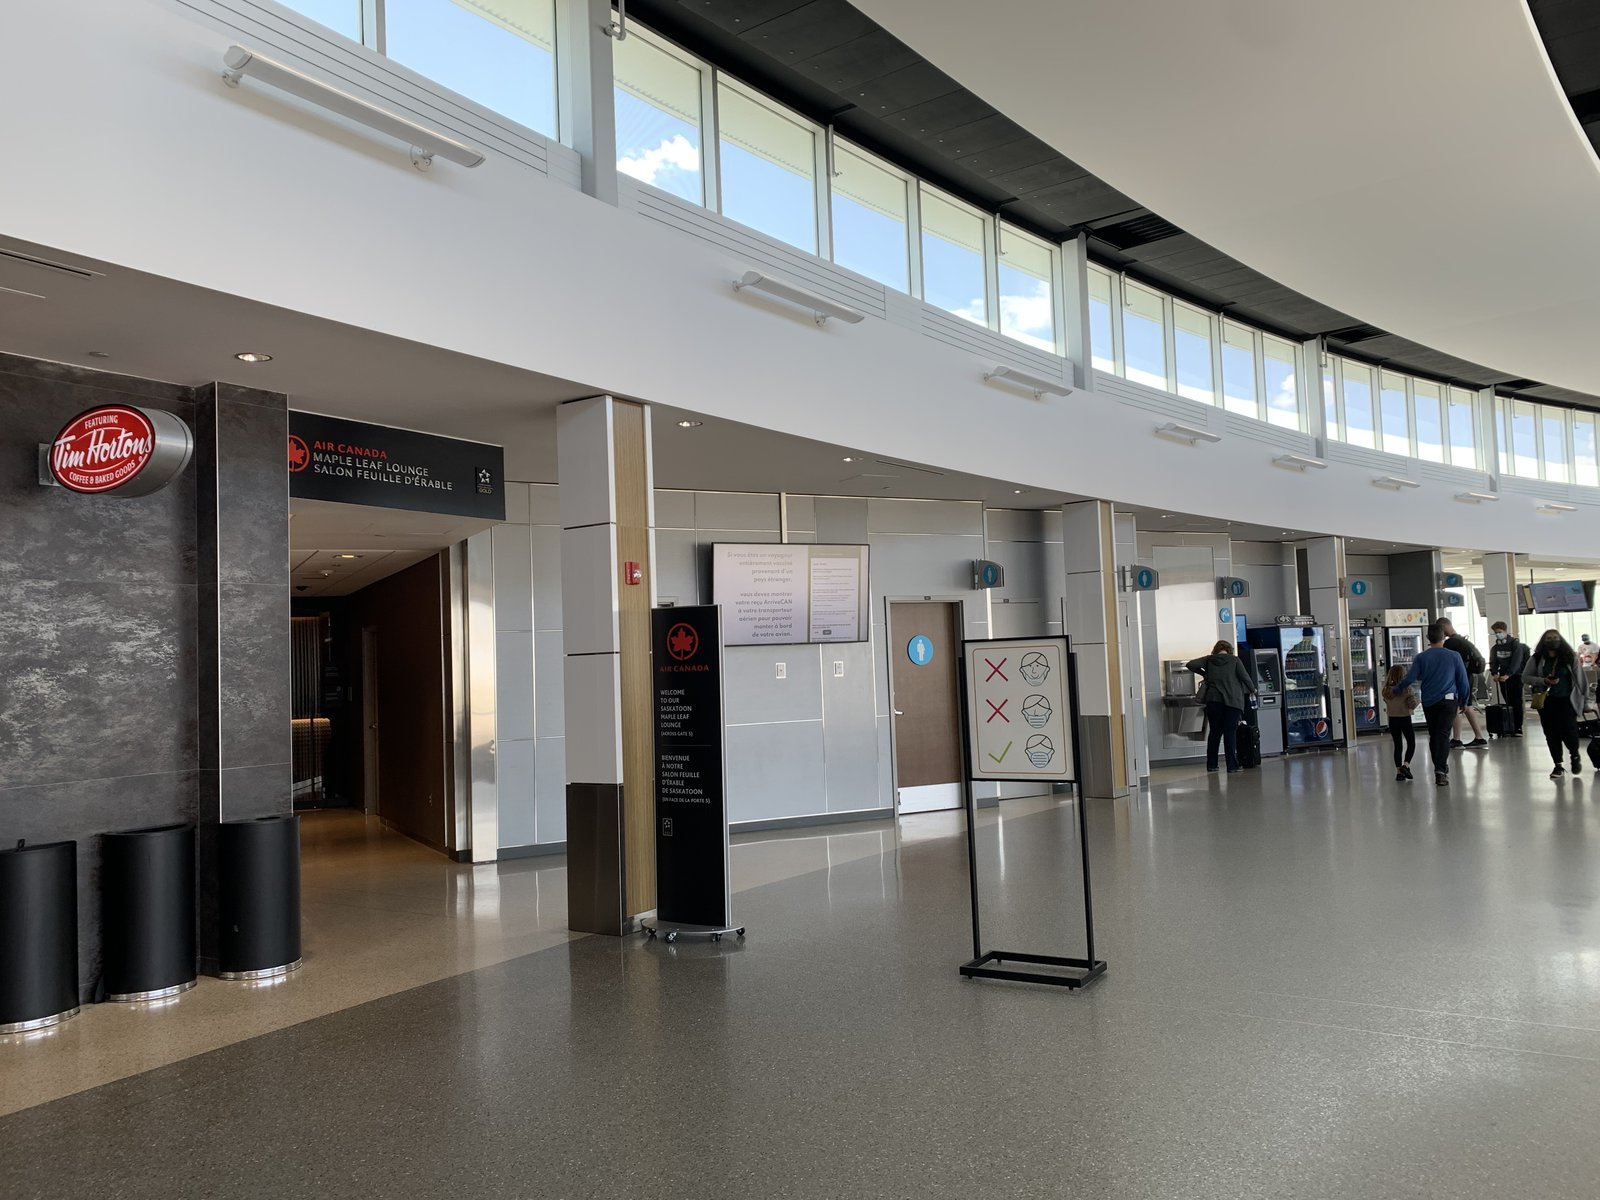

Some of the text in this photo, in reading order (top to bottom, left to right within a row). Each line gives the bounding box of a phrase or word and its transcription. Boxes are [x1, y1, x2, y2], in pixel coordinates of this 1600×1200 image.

[84, 414, 118, 430] FEATURING
[54, 428, 152, 472] Tim Hortons
[314, 440, 388, 460] AIR CANADA
[69, 472, 89, 484] COFFEE
[95, 472, 114, 484] BAKED
[115, 460, 136, 478] GOODS
[313, 452, 429, 477] MAPLE LEAF LOUNGE
[314, 464, 453, 490] SALON FEUILLE D'ÉRABLE
